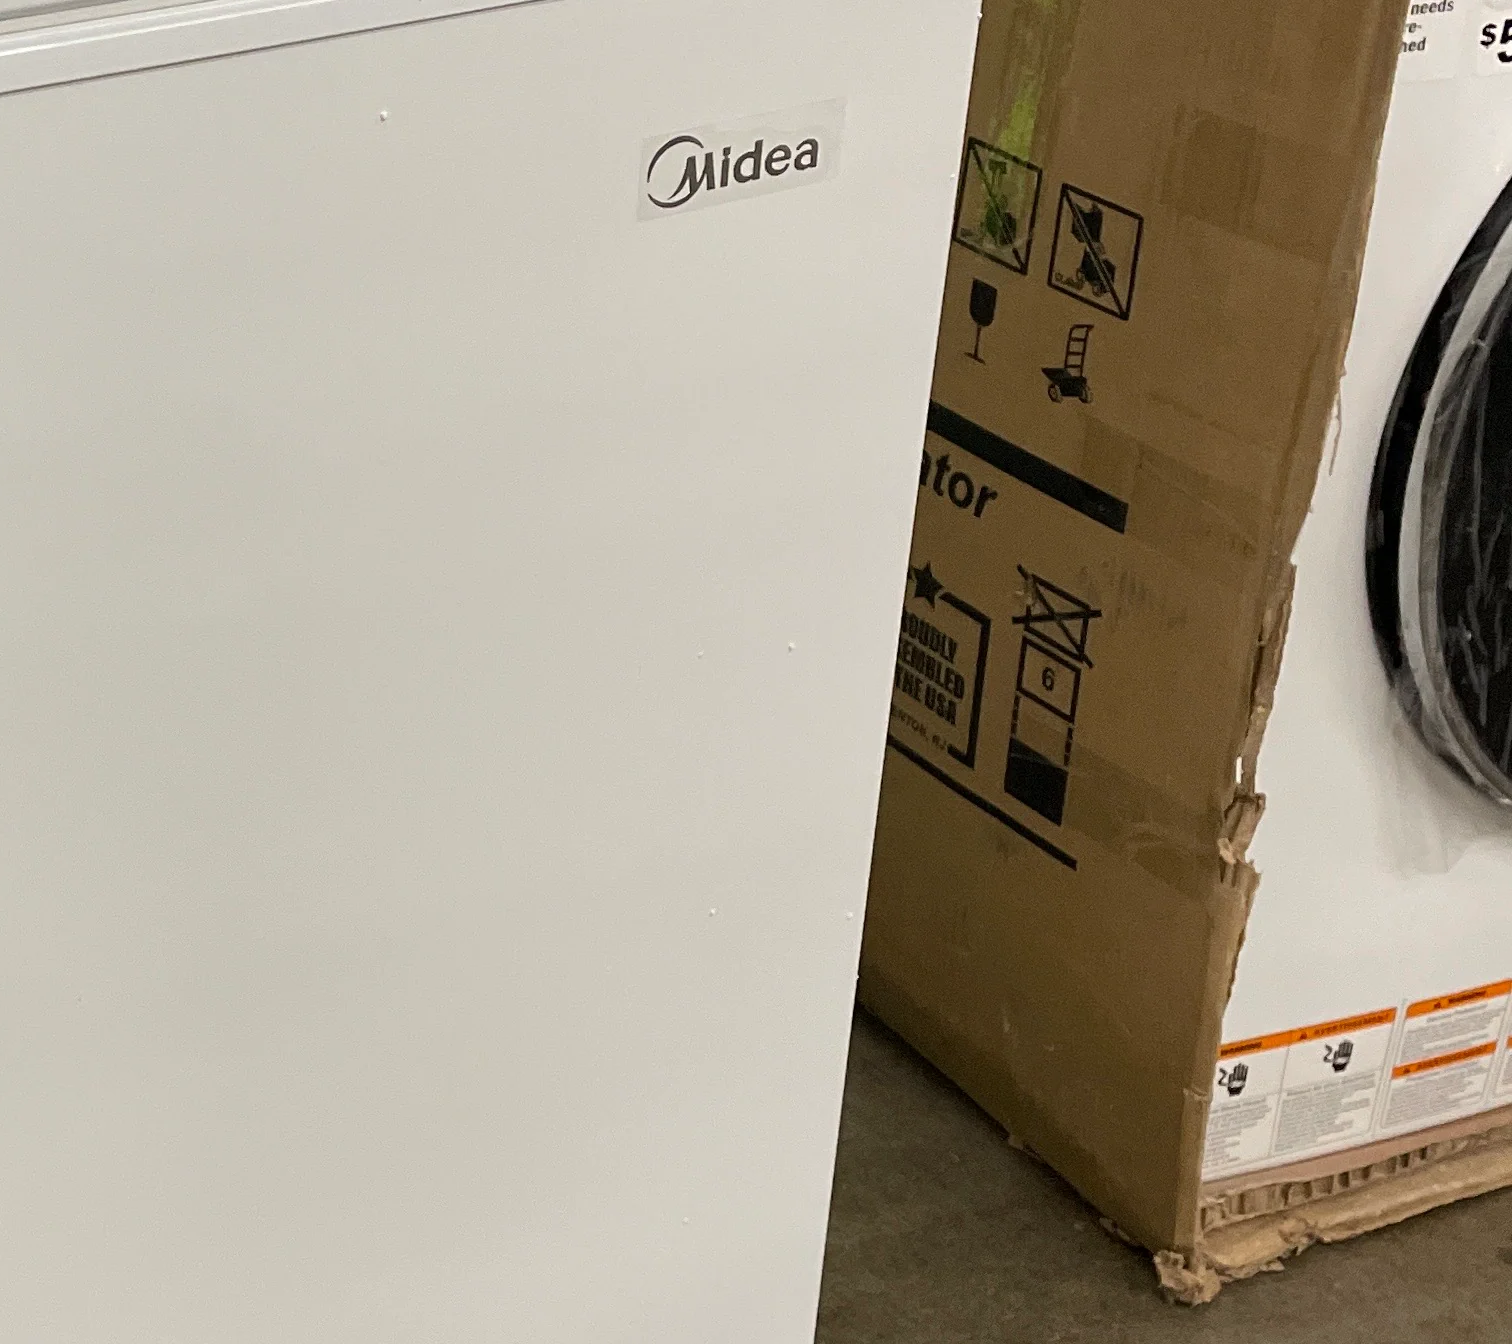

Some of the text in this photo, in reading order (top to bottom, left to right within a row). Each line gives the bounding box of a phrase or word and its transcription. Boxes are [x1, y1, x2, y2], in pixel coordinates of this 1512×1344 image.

[647, 135, 819, 209] Midea
[901, 610, 958, 664] OUDLY
[897, 635, 965, 700] EMBLED
[1041, 666, 1056, 692] 6
[924, 683, 957, 726] USA
